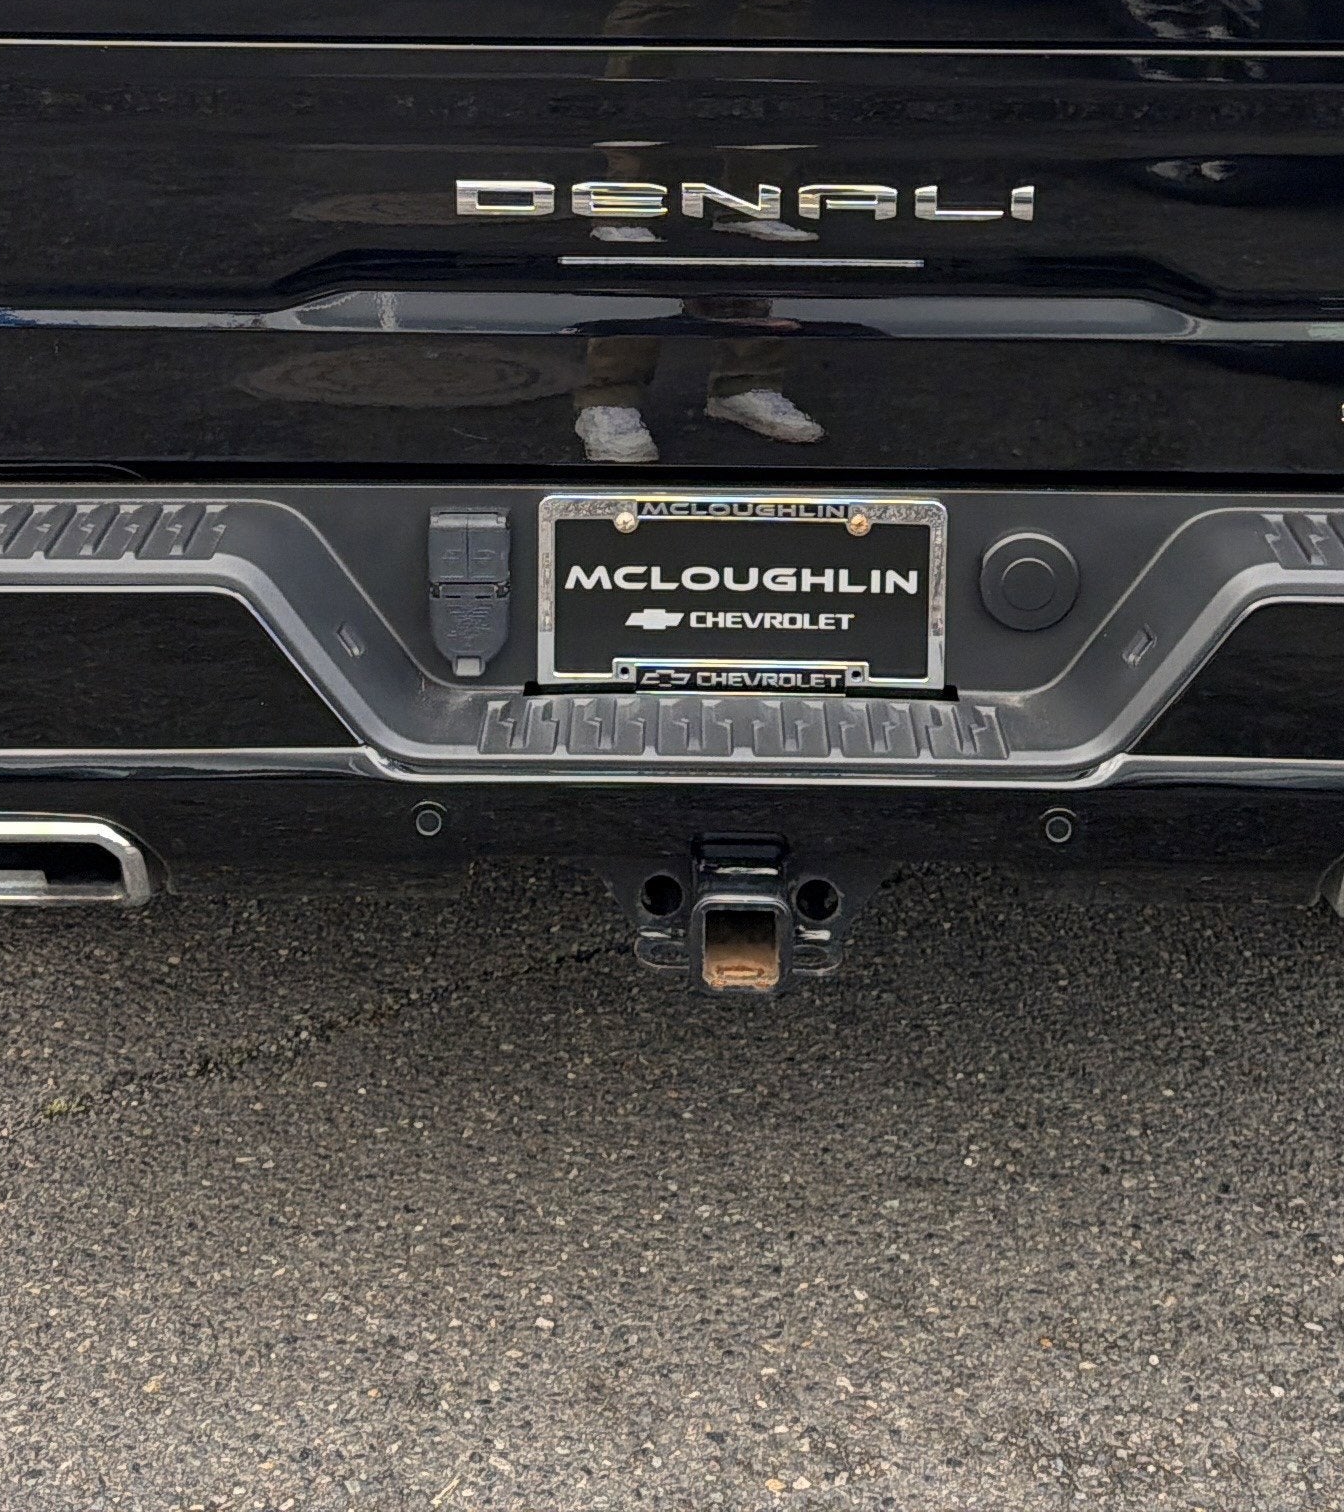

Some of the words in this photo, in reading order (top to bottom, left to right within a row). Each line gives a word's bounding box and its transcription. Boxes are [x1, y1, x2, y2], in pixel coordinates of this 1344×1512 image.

[456, 180, 1035, 221] DENALI
[641, 502, 847, 519] MCLOUGHLIN
[564, 565, 918, 595] MCLOUGHLIN
[689, 611, 854, 630] CHEVROLET
[696, 671, 842, 688] CHEVROLET
